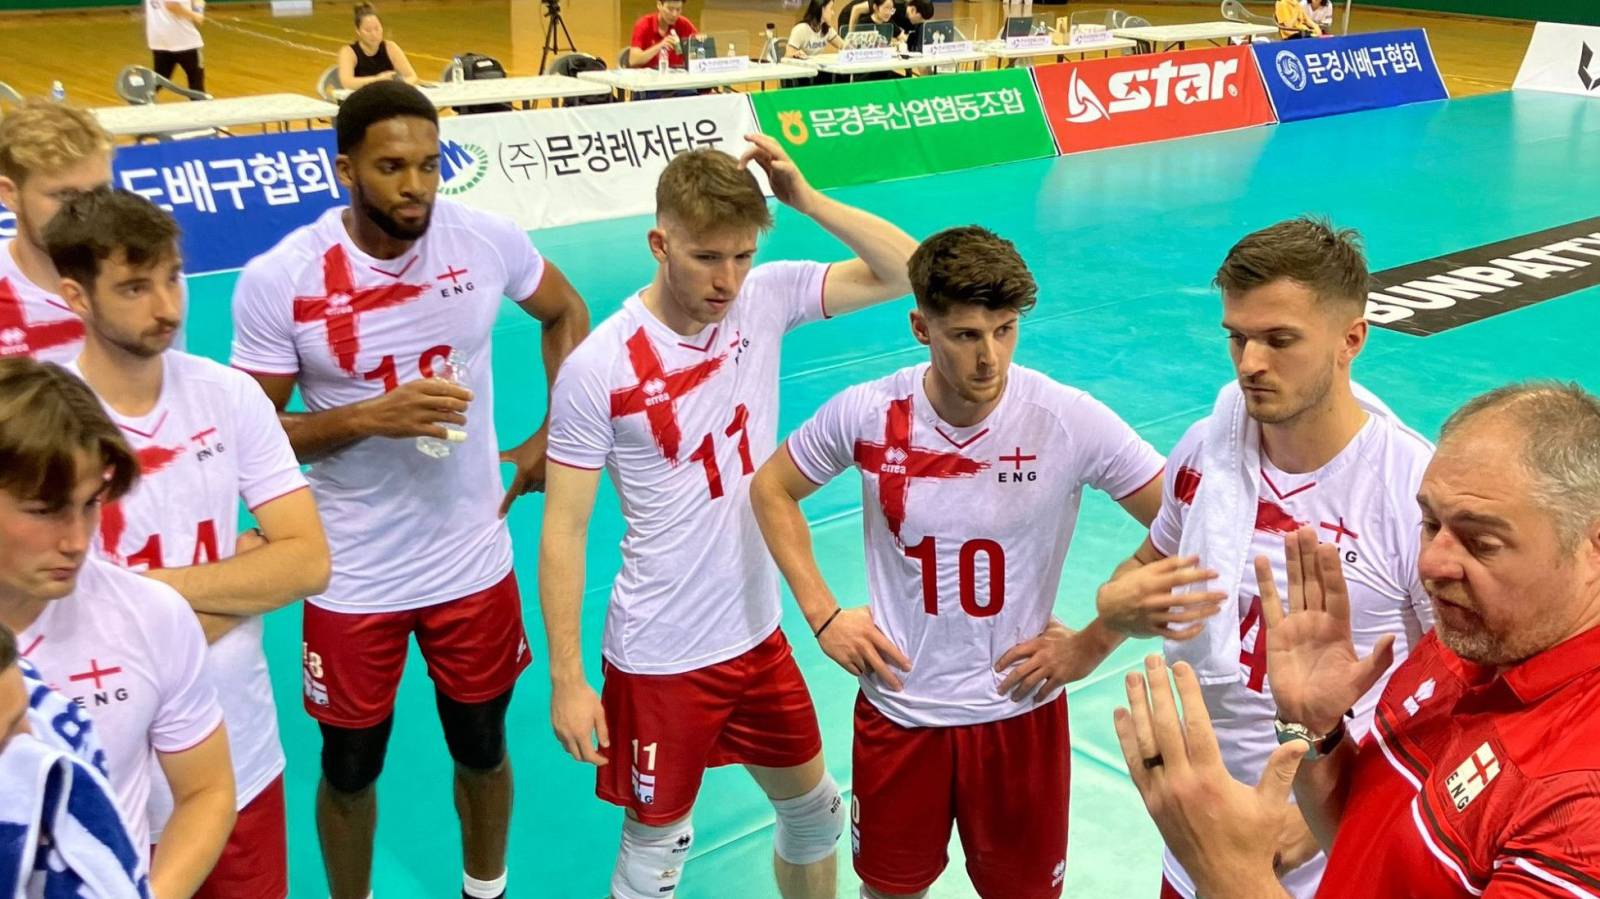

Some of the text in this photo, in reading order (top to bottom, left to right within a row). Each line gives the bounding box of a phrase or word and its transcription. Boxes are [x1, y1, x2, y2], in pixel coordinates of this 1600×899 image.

[1306, 42, 1423, 85] 문경시배구협회
[809, 87, 1025, 138] 문경축산업협동조합
[440, 282, 475, 298] ENG
[690, 402, 755, 500] 11
[998, 471, 1037, 483] ENG
[904, 535, 1006, 618] 10
[72, 687, 129, 709] ENG
[1446, 770, 1469, 811] ENG
